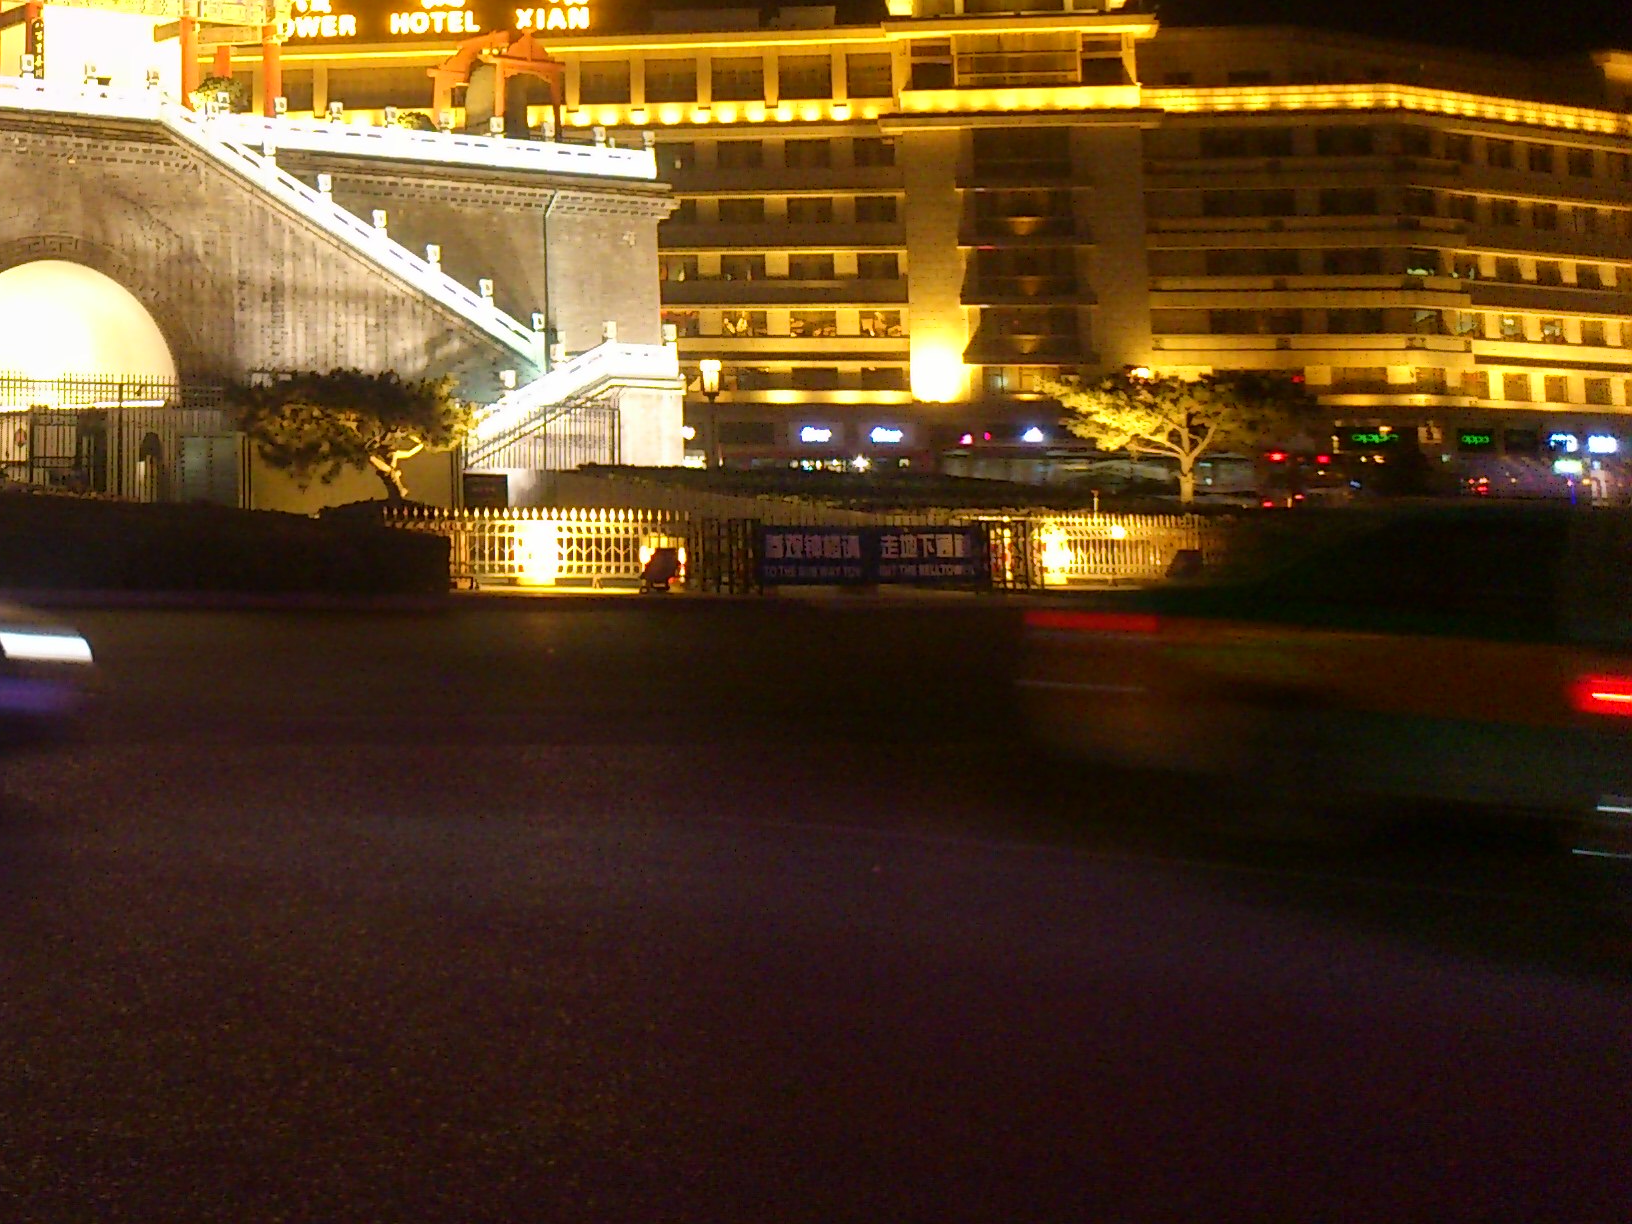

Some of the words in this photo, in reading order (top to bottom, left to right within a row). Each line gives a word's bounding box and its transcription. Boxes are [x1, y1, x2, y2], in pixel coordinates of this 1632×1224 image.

[276, 14, 357, 38] OWER
[389, 10, 481, 35] HOTEL
[515, 7, 590, 31] XIAN
